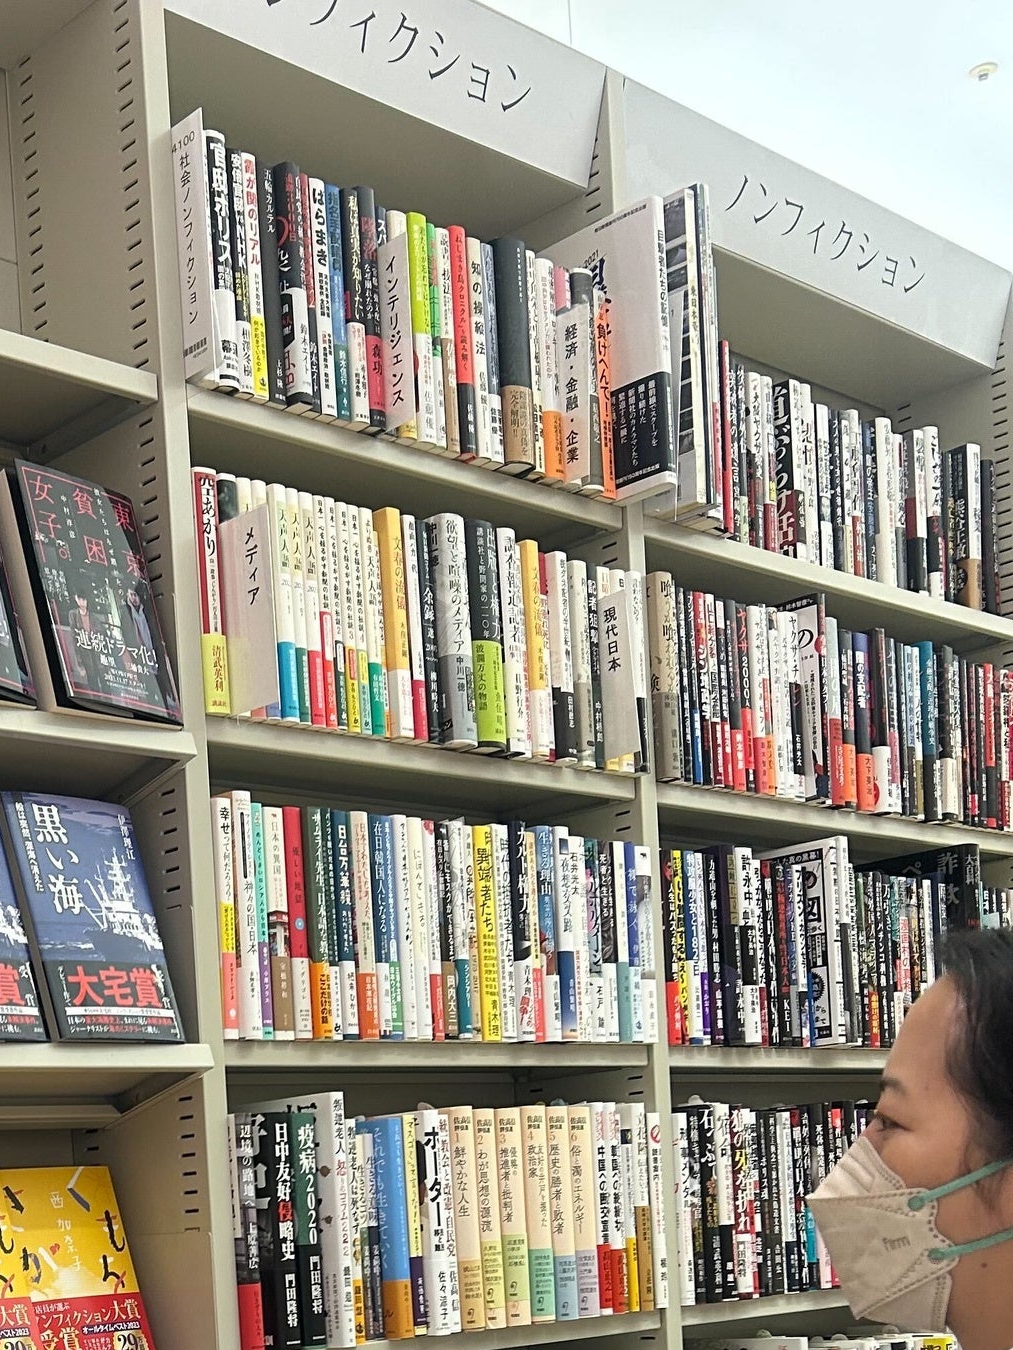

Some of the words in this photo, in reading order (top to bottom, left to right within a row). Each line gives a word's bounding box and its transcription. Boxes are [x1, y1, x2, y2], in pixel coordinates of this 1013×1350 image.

[267, 0, 531, 112] フィクション
[172, 130, 195, 152] 4100
[179, 152, 197, 325] 社会ノンフィクション
[264, 169, 275, 233] 五輪カルテル
[725, 175, 925, 293] ノンフィクション
[385, 255, 405, 406] インテリジェンス
[471, 259, 486, 356] 知の操縦法
[564, 325, 579, 464] 経済・金融・企業
[29, 474, 69, 560] 女子。
[72, 488, 108, 566] 貧困
[244, 526, 260, 605] メディア
[75, 628, 159, 667] 連続ドラマ化!
[212, 645, 224, 692] 清武英利
[603, 608, 621, 672] 現代日本
[31, 803, 84, 916] 黒い海
[67, 965, 162, 1007] 大宅賞
[274, 1123, 295, 1261] 日中友好侵略史
[297, 1124, 318, 1246] 疫病2020
[454, 1145, 470, 1218] 鮮やかな人生
[477, 1151, 493, 1232] わが思想の源流
[549, 1144, 564, 1235] 歴史の勝者と敗者
[82, 1322, 140, 1335] オールタイムベスト2023
